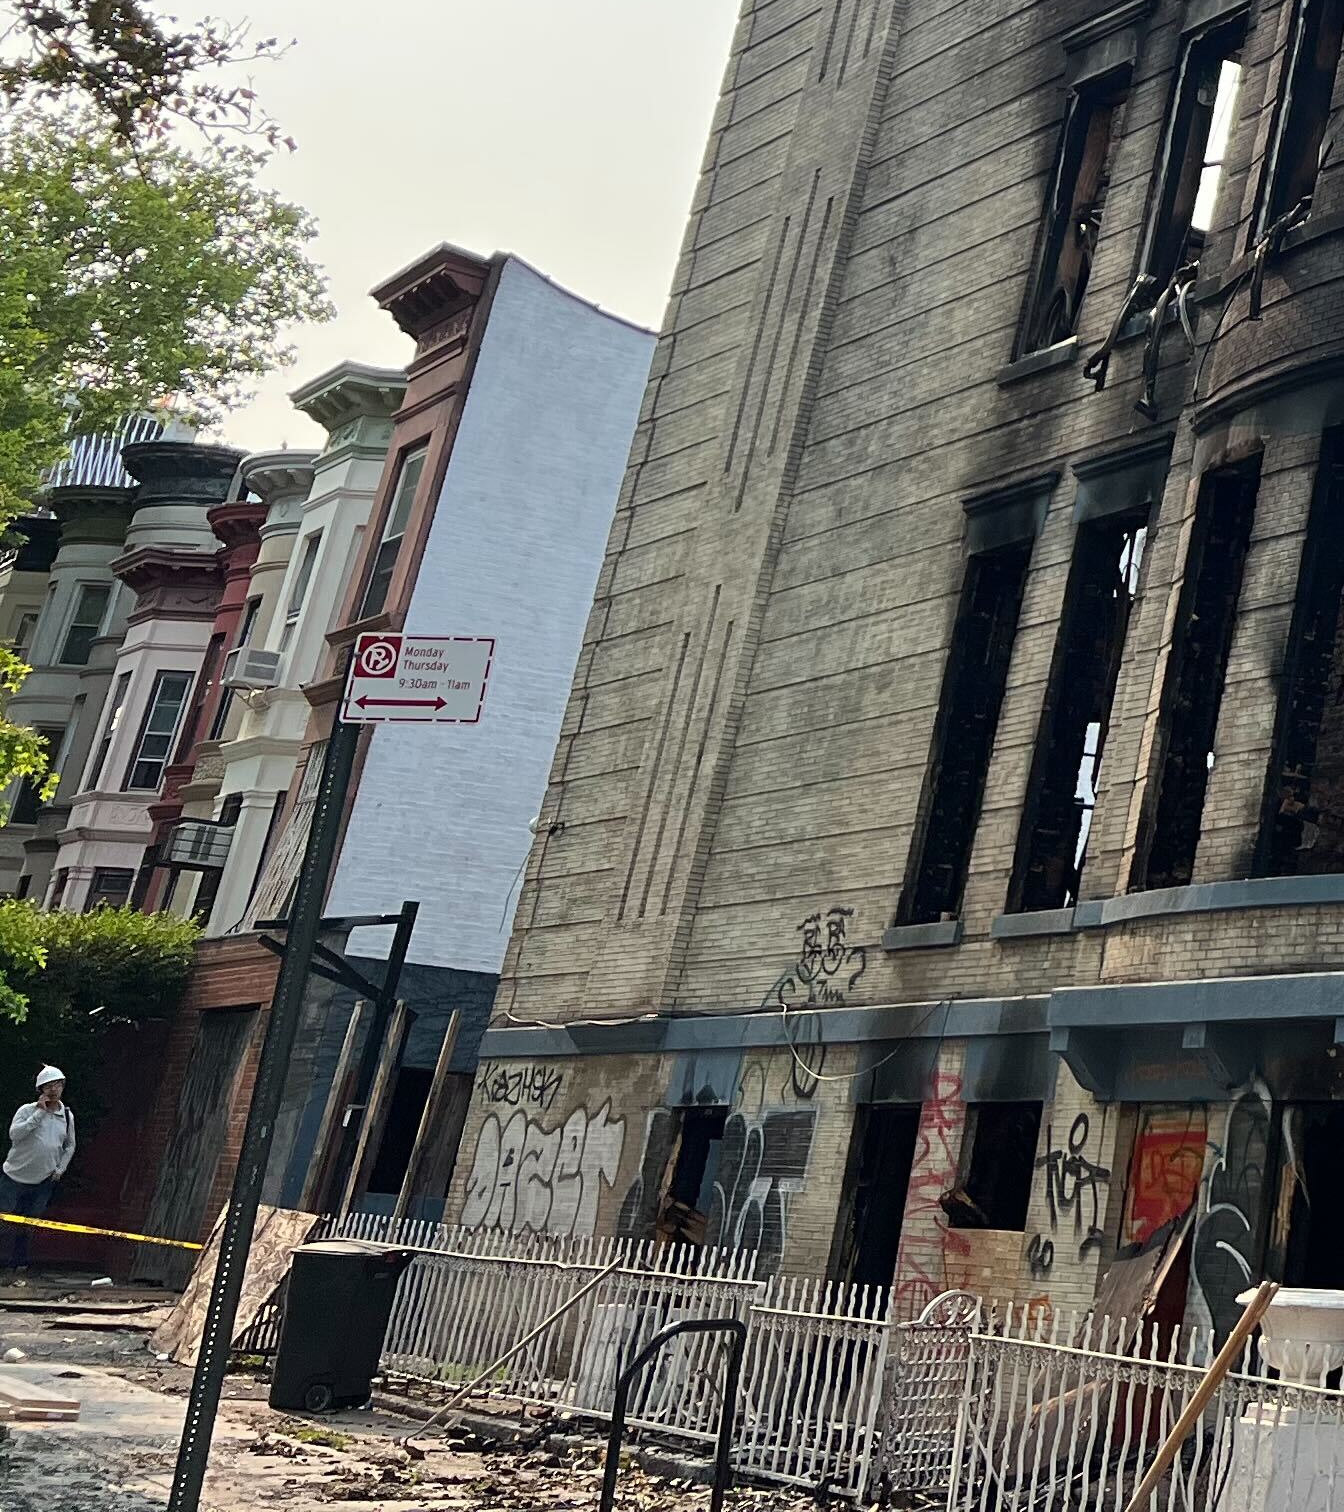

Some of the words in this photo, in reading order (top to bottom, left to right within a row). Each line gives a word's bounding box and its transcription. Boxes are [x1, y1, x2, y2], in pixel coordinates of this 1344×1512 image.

[404, 646, 445, 658] Monday
[403, 660, 449, 673] Thursday
[399, 678, 438, 689] 9:30am
[447, 679, 471, 690] 11am
